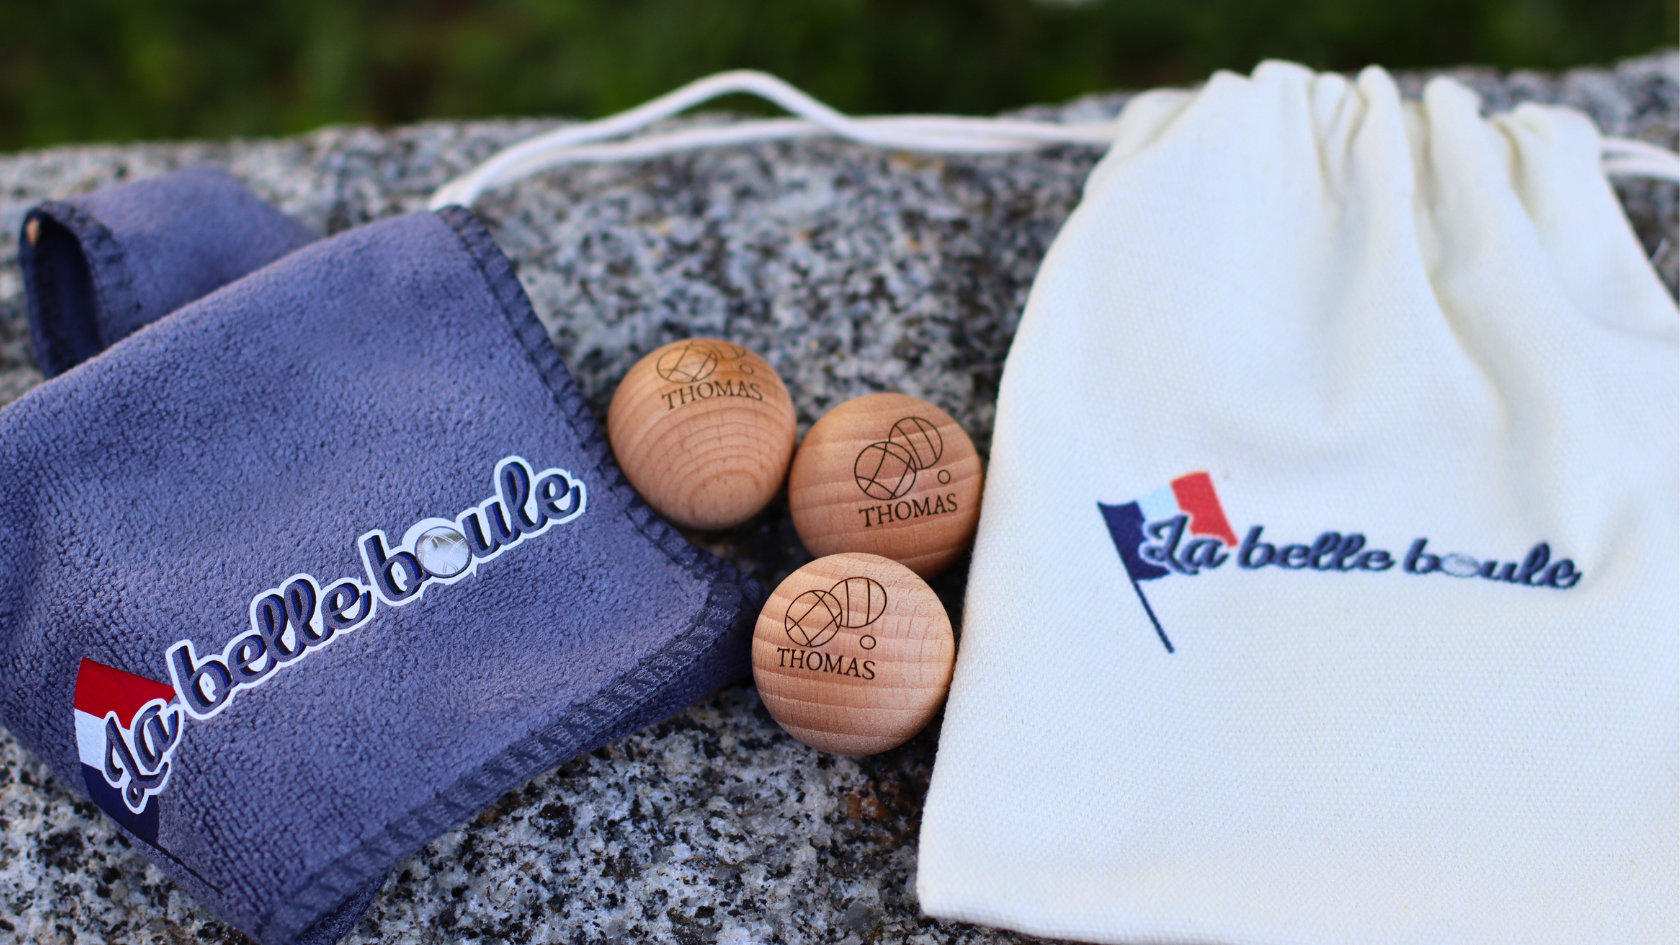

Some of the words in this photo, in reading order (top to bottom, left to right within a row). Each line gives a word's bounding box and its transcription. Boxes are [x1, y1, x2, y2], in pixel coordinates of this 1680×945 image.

[661, 380, 763, 410] THOMAS
[858, 493, 958, 527] THOMAS
[1142, 514, 1230, 575] La
[1237, 525, 1396, 572] belle
[1403, 537, 1582, 589] boule
[102, 701, 180, 811] La
[172, 577, 371, 709] belle
[363, 460, 581, 599] boule
[776, 647, 876, 680] THOMAS
